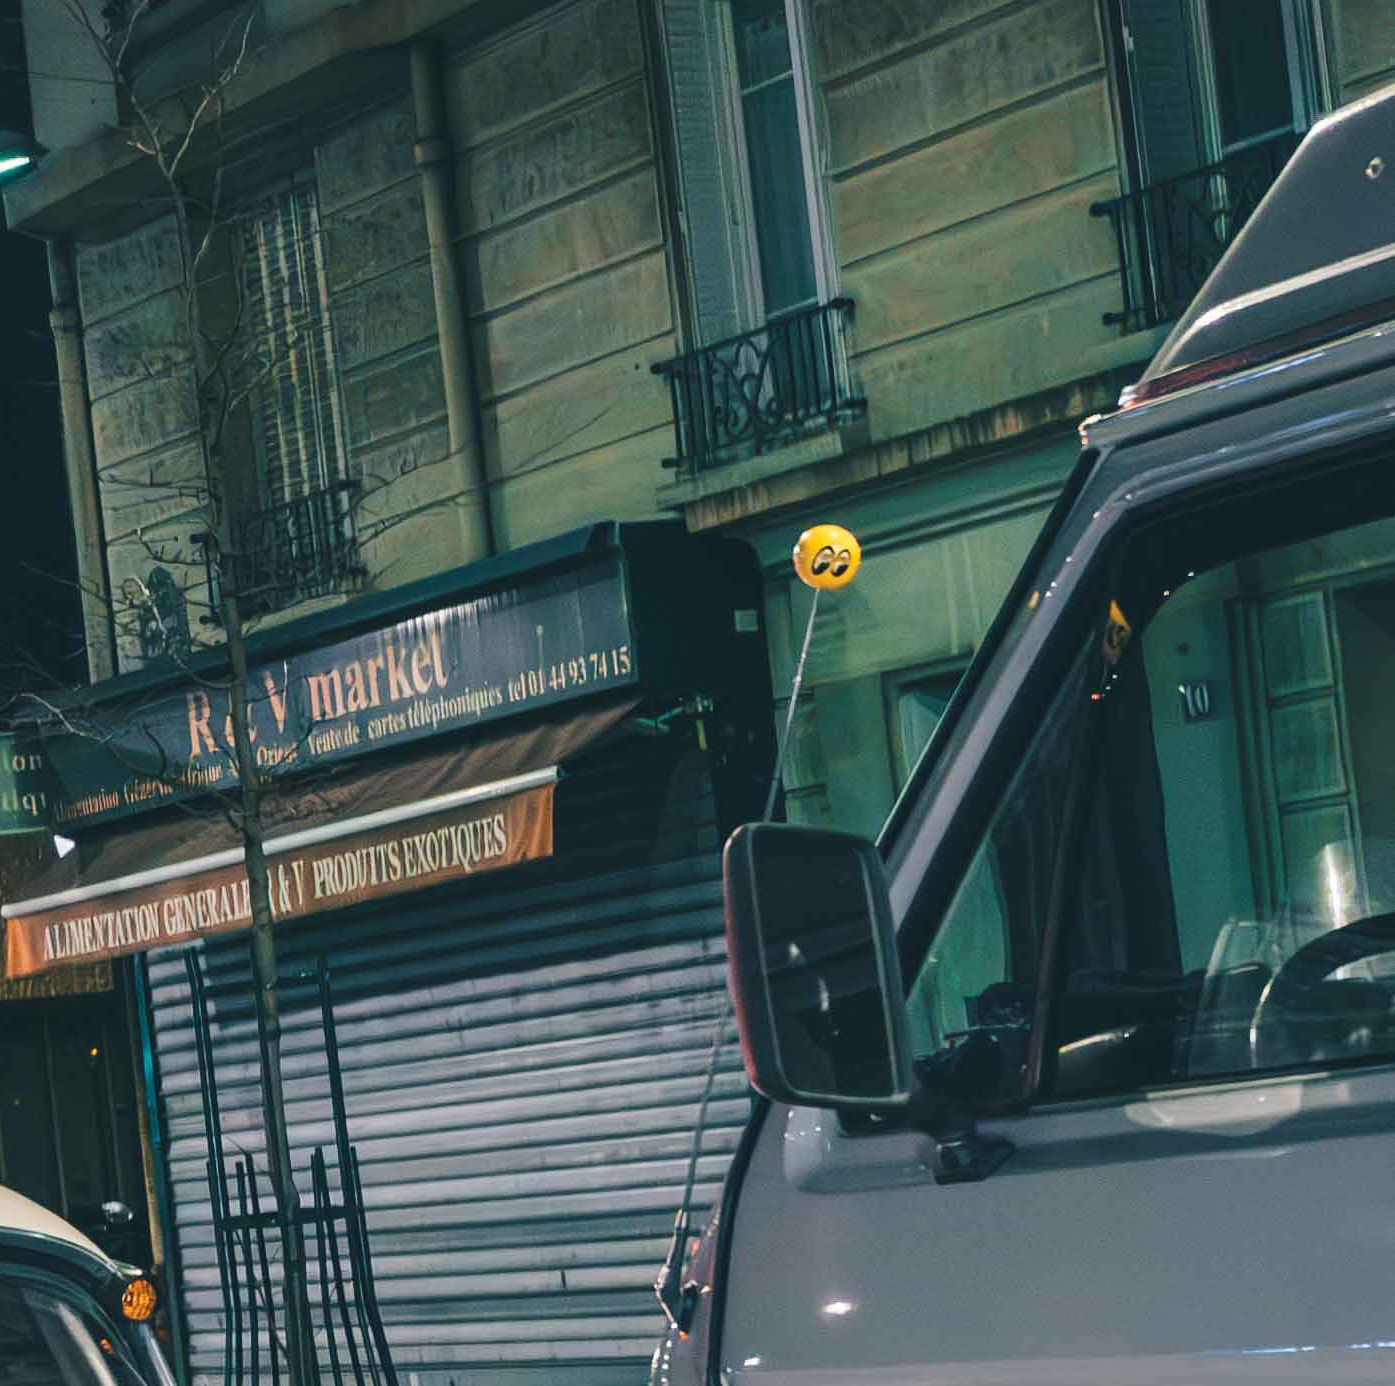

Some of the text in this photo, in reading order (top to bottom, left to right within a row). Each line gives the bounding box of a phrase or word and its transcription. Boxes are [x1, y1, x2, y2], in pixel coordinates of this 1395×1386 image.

[186, 690, 218, 758] R
[265, 662, 287, 735] V
[304, 631, 447, 722] market
[549, 662, 567, 691] 44
[569, 656, 587, 685] 93
[589, 652, 608, 679] 74
[611, 645, 631, 676] 15
[44, 904, 160, 960] ALIMENTATION
[313, 840, 400, 899] PRODUITS
[402, 813, 507, 878] EXOTIQUES
